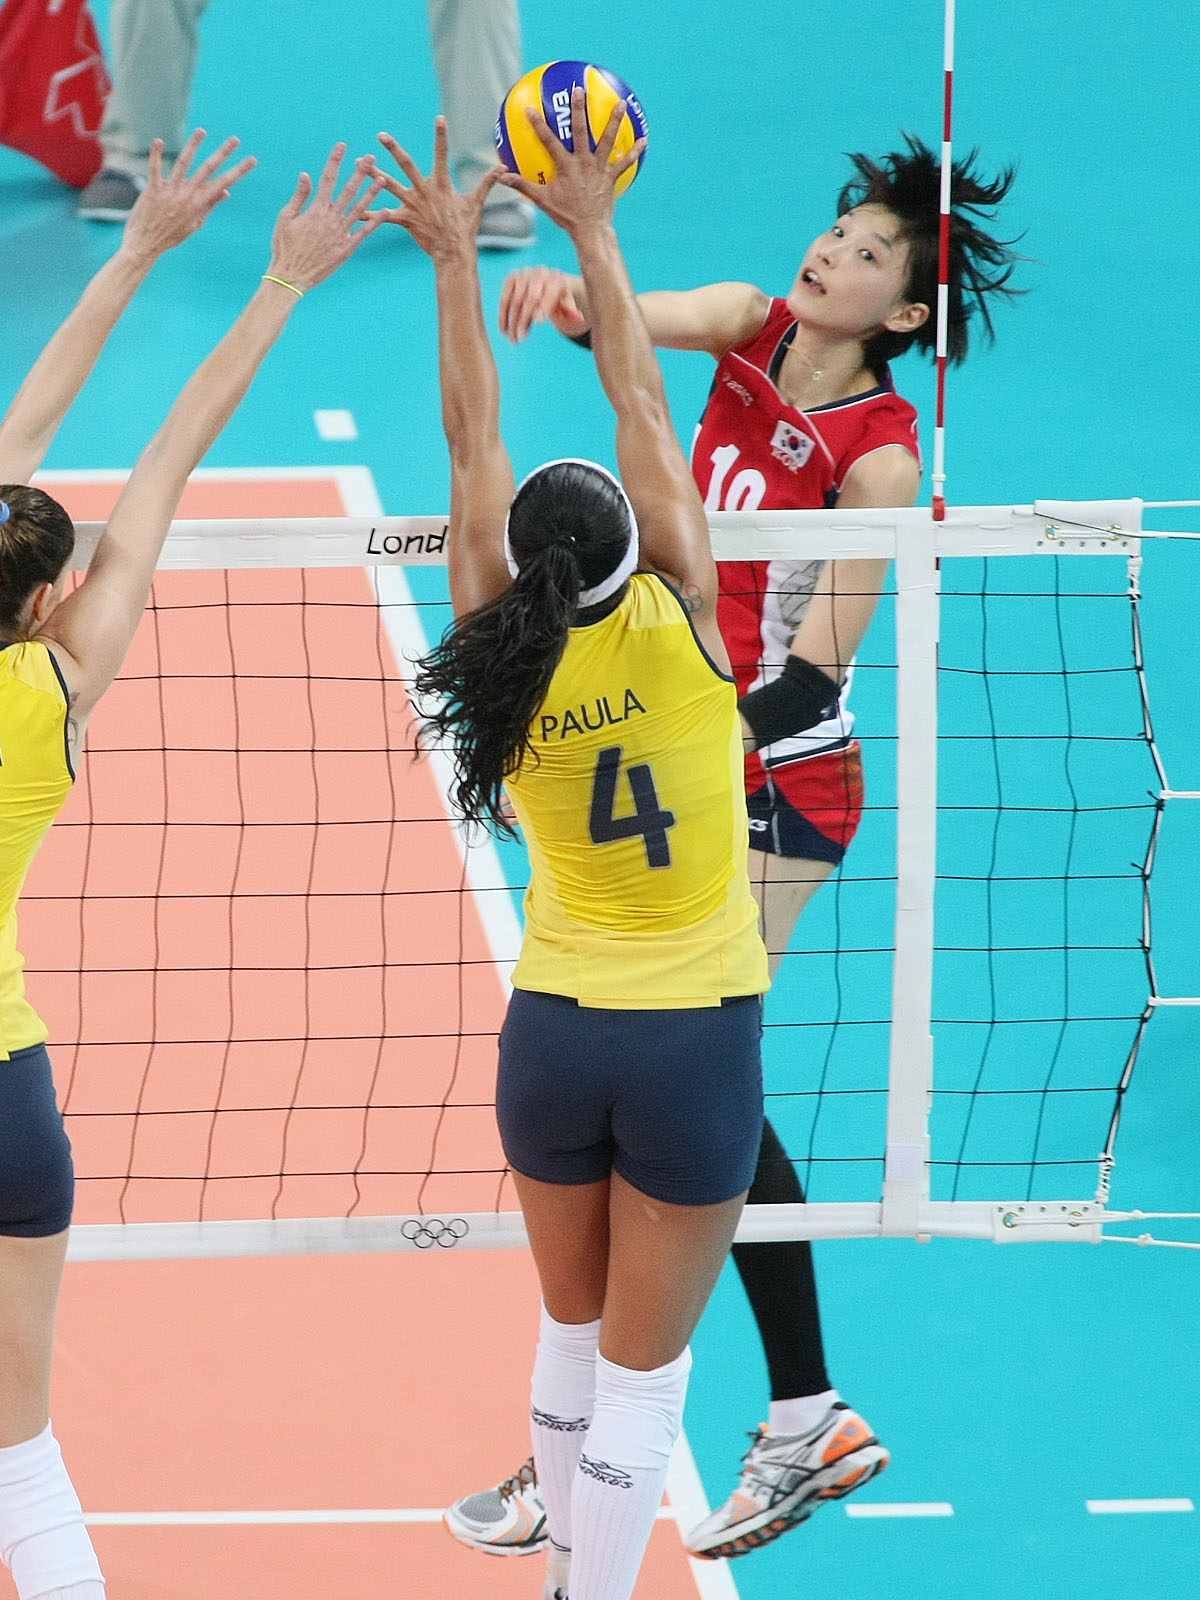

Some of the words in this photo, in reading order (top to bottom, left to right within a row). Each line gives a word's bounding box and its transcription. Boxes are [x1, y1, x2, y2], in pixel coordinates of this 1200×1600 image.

[366, 524, 449, 555] Lond
[541, 688, 647, 742] PAULA
[589, 745, 676, 869] 4
